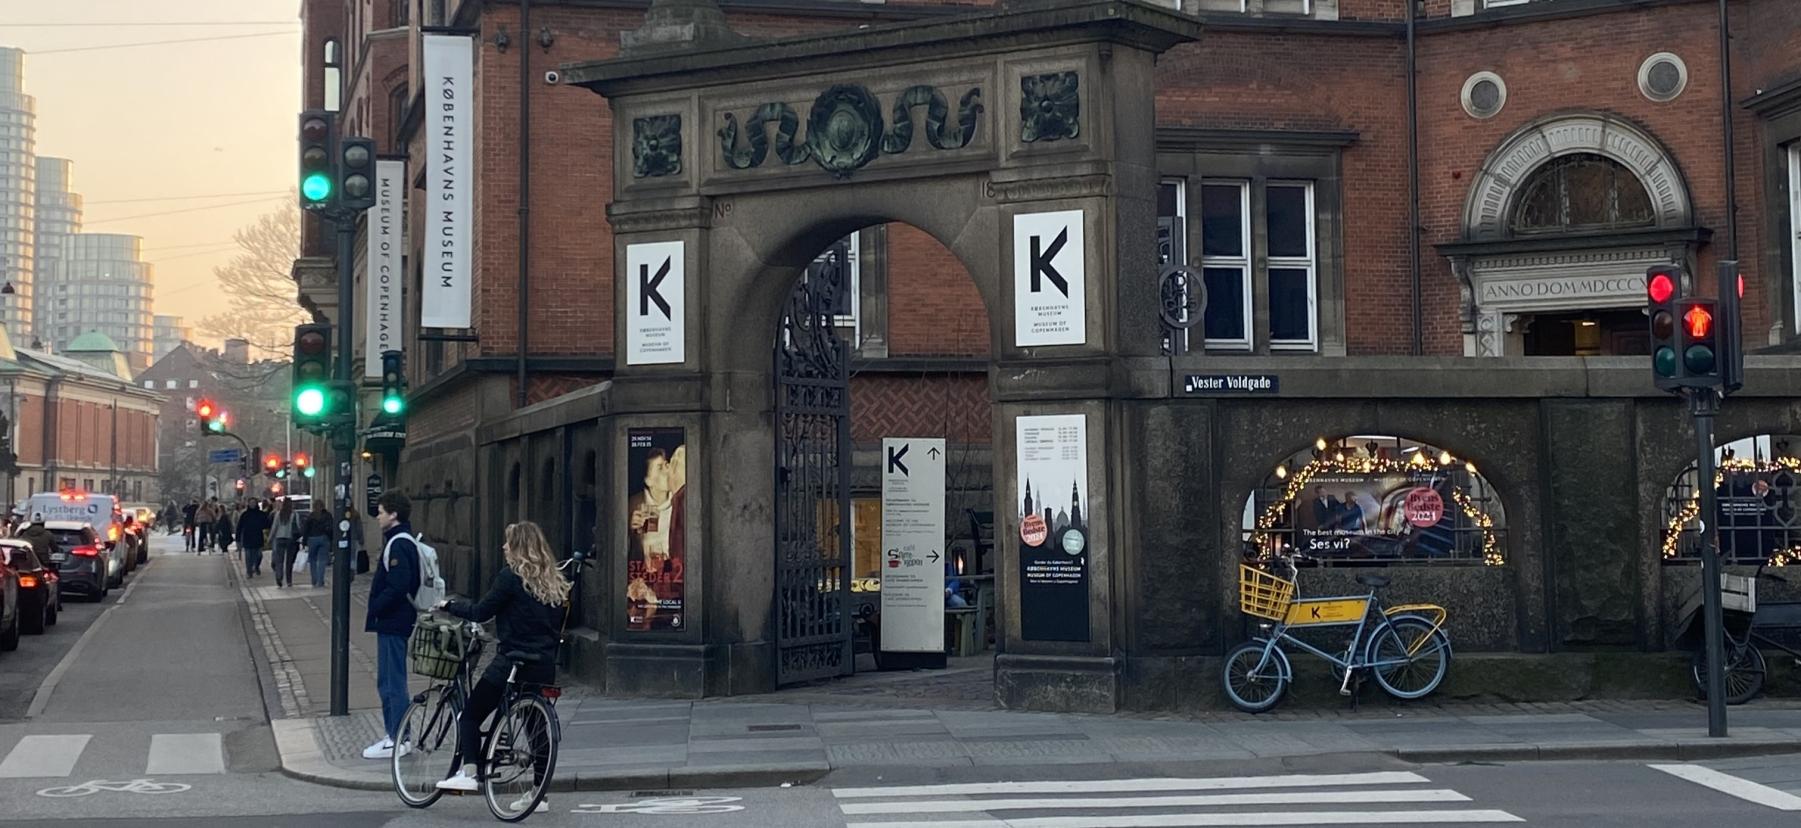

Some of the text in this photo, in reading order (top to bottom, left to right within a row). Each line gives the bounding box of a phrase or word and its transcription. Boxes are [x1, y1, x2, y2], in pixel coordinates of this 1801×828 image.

[441, 76, 455, 288] KØBENHAVNS MUSEUM
[380, 178, 391, 235] MUSEUM
[381, 241, 391, 258] OF
[1029, 225, 1068, 299] K
[640, 254, 671, 322] K
[1484, 283, 1534, 298] ANNO
[1537, 281, 1577, 296] DOM
[1192, 376, 1271, 392] Vester Voldgade
[888, 443, 909, 477] K
[1303, 528, 1316, 536] The
[1317, 528, 1332, 536] best
[1309, 538, 1350, 550] Ses vi?
[672, 557, 683, 583] 2
[1311, 606, 1321, 619] K
